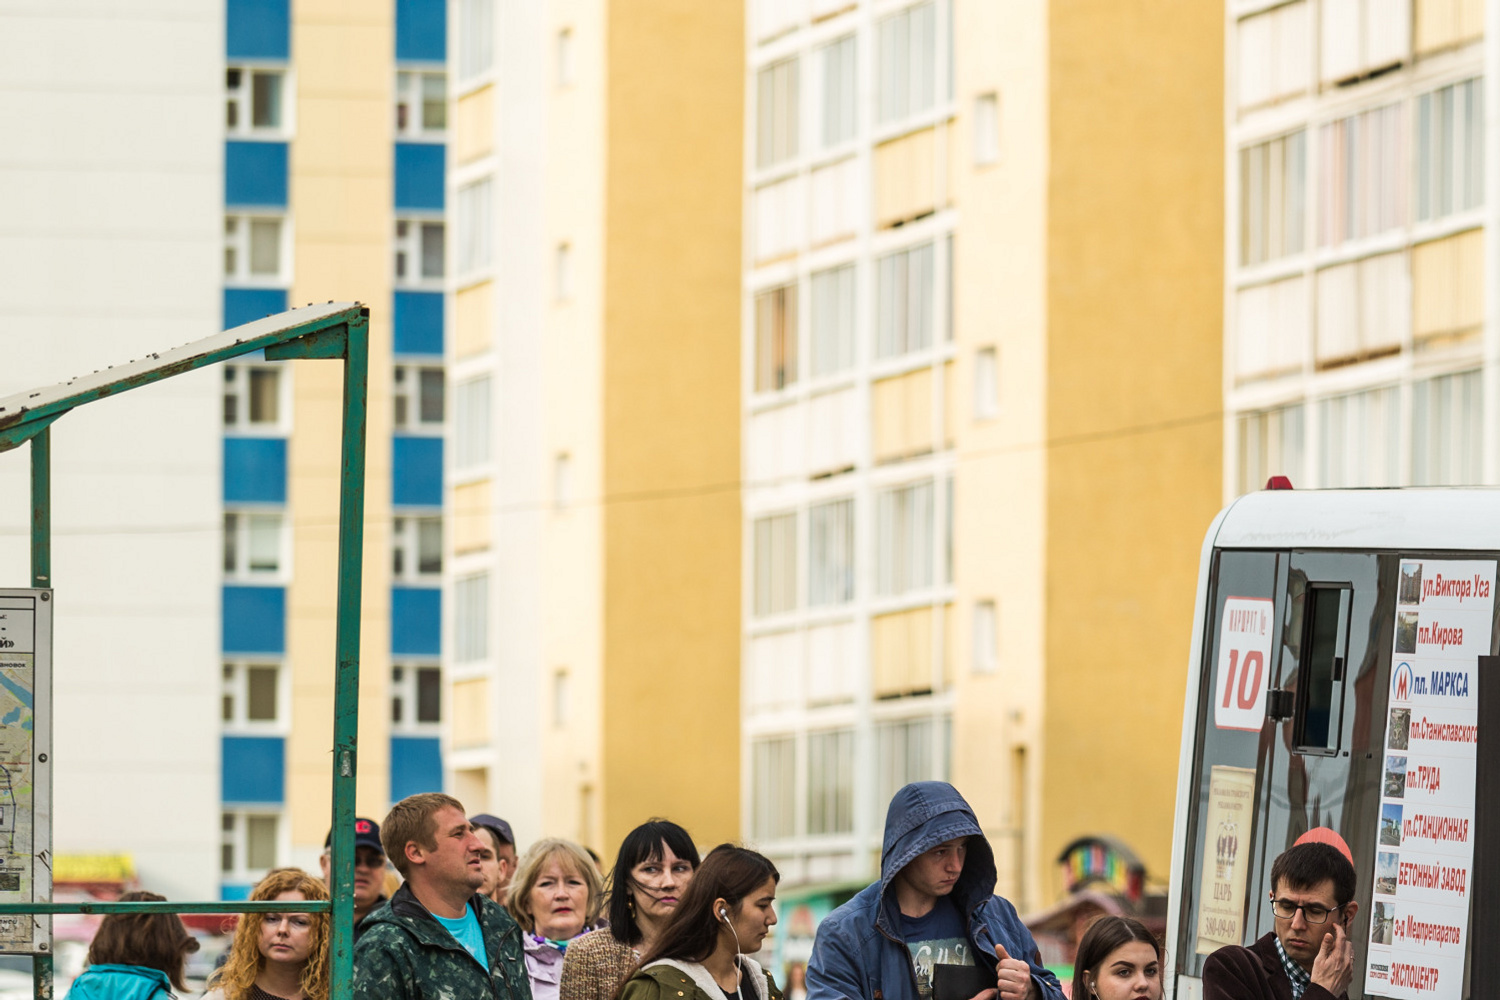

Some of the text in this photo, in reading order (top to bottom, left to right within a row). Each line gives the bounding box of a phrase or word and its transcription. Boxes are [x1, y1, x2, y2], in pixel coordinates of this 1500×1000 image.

[1422, 574, 1490, 603] ул.Виктора Уса
[1229, 610, 1257, 632] МАРШРУТ
[1418, 621, 1463, 650] пл.Кирова
[1222, 649, 1263, 710] 10
[1414, 671, 1469, 697] пл. МАРКСА
[1406, 766, 1440, 795] пл.ТРУДА
[1402, 814, 1469, 844] ул.СТАНЦИОННАЯ
[1213, 882, 1232, 902] ЦАРЬ
[1399, 861, 1467, 897] БЕТОННЫЙ ЗАВОД
[1394, 915, 1461, 948] з-д Медпрепаратов
[1390, 962, 1439, 993] ЭКСПОЦЕНТР
